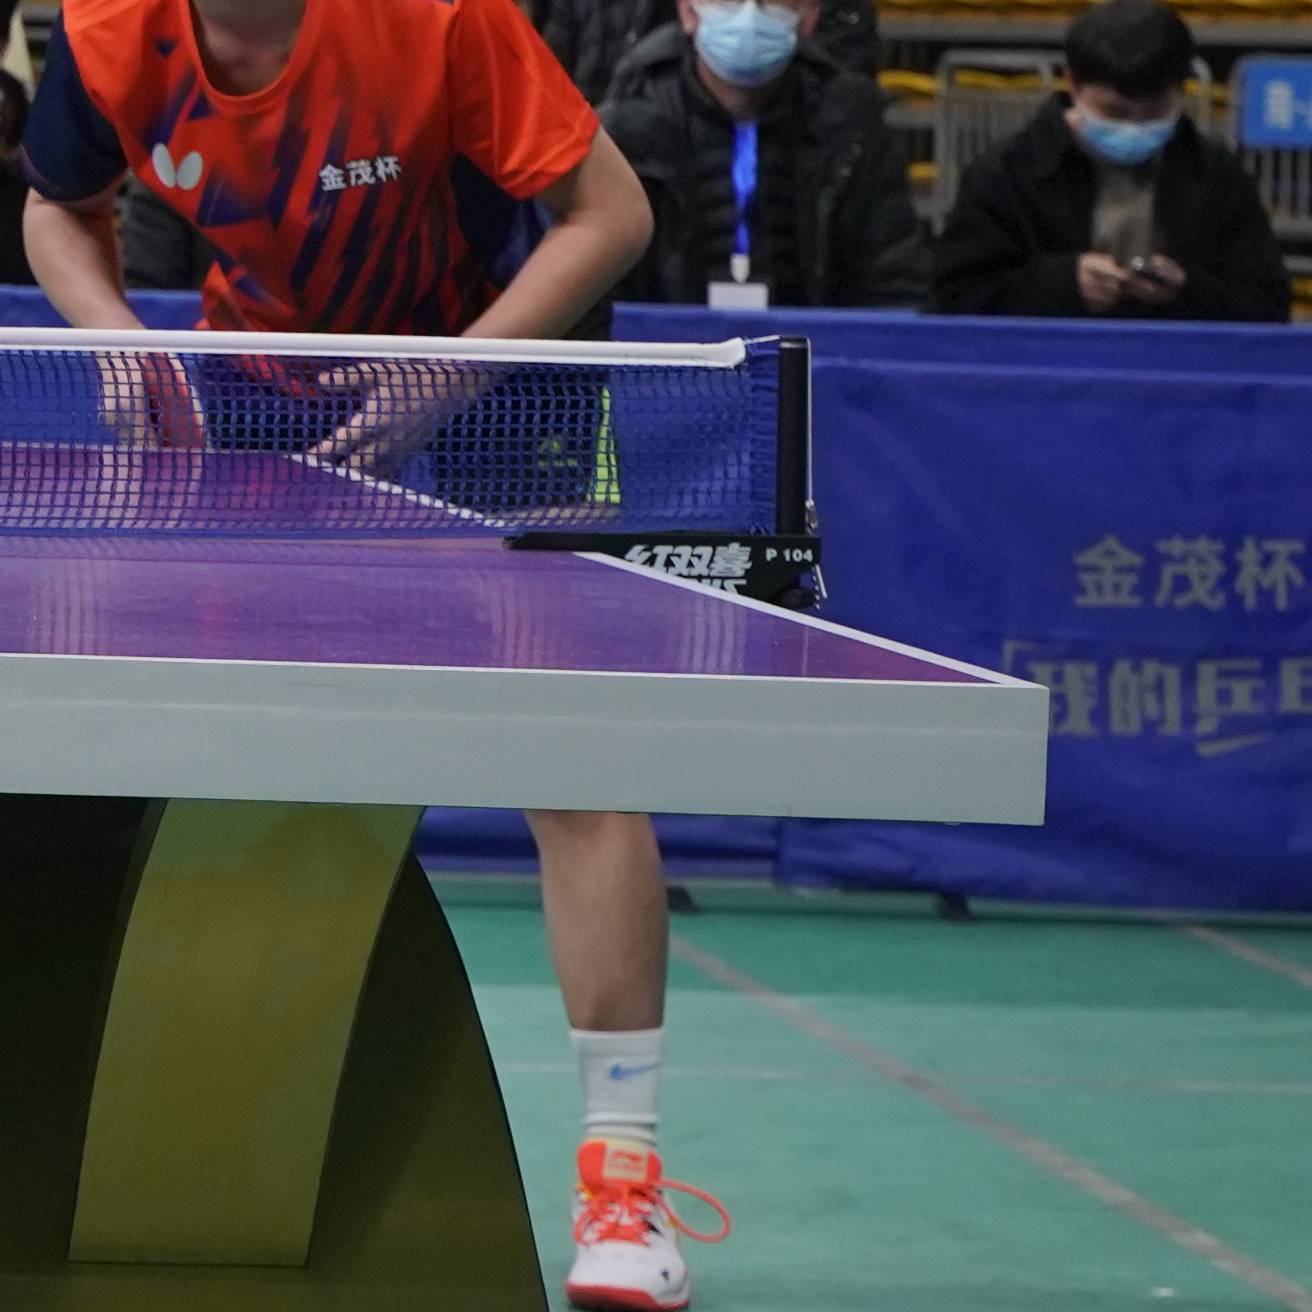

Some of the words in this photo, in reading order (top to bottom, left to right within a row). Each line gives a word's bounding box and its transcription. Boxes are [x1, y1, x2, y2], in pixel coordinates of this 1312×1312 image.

[319, 155, 403, 192] 金茂杯
[624, 541, 753, 578] 红双喜
[765, 547, 777, 562] P
[783, 548, 814, 563] 104
[1074, 533, 1305, 611] 金茂杯
